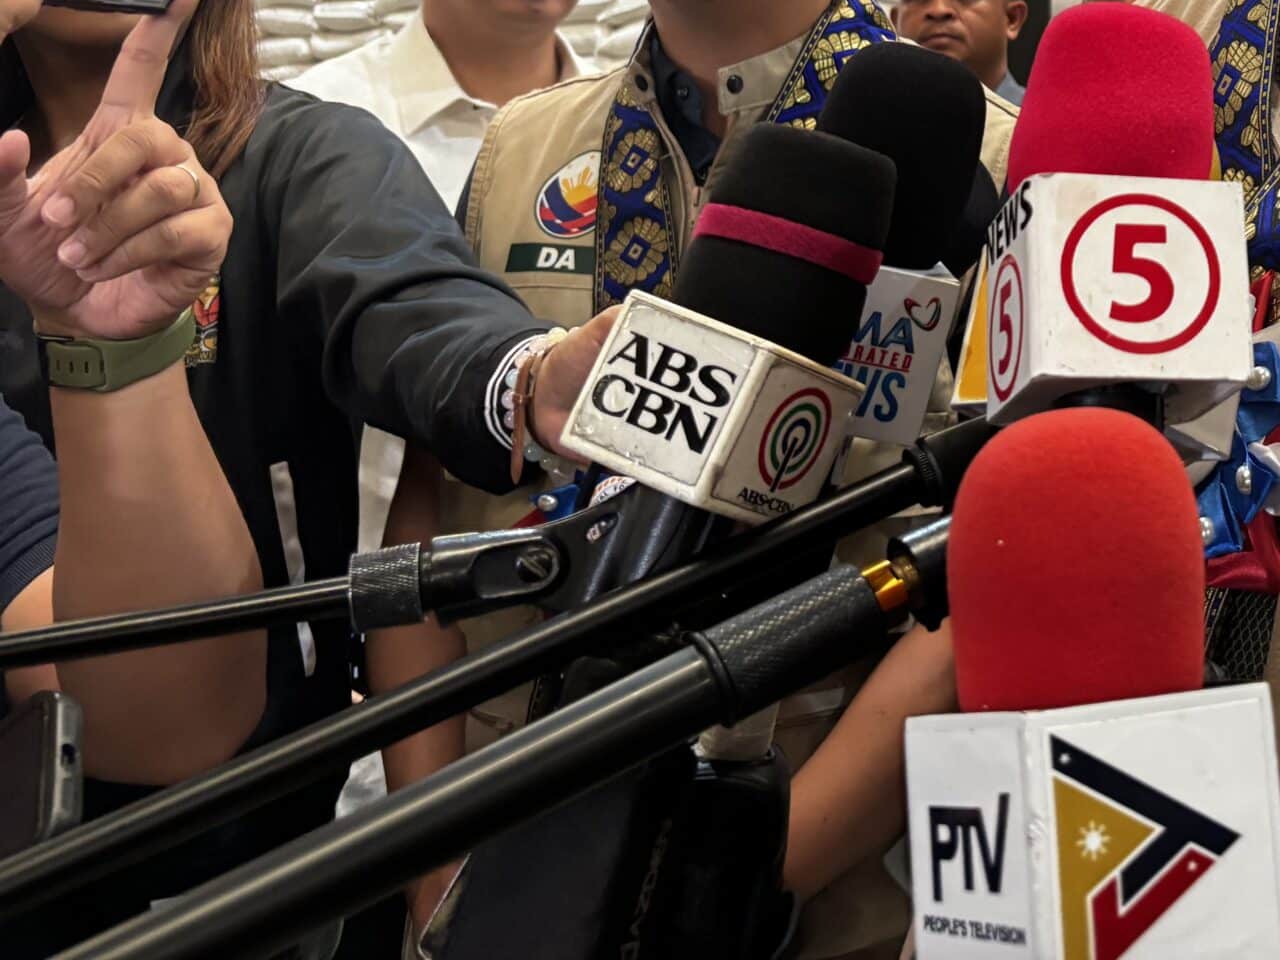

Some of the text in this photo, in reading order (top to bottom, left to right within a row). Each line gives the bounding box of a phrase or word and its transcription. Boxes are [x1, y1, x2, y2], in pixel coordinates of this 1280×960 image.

[536, 247, 576, 270] DA
[986, 181, 1033, 264] NEWS
[1109, 223, 1174, 323] 5
[999, 281, 1013, 375] 5
[608, 331, 737, 408] ABS
[591, 374, 718, 455] CBN
[929, 793, 1010, 902] PTV
[923, 914, 1026, 946] PEOPLE'S TELEVISION
